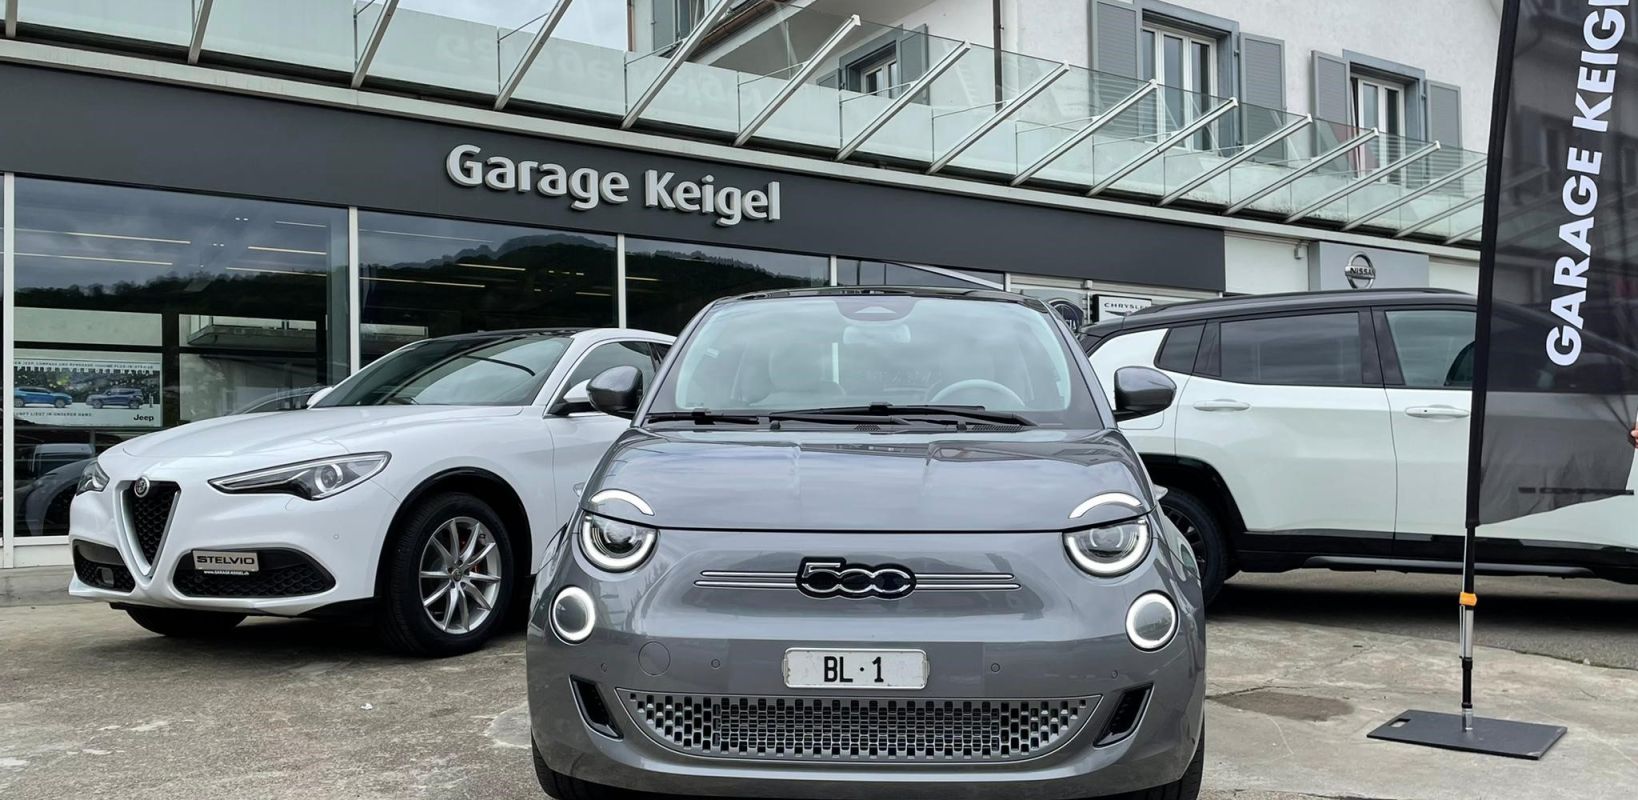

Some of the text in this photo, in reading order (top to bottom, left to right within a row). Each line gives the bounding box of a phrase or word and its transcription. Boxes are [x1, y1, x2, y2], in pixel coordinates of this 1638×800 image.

[446, 144, 781, 227] Garage Keigel
[1545, 0, 1630, 367] GARAGE KEIG
[196, 555, 255, 565] STELVIO
[800, 560, 912, 594] 500
